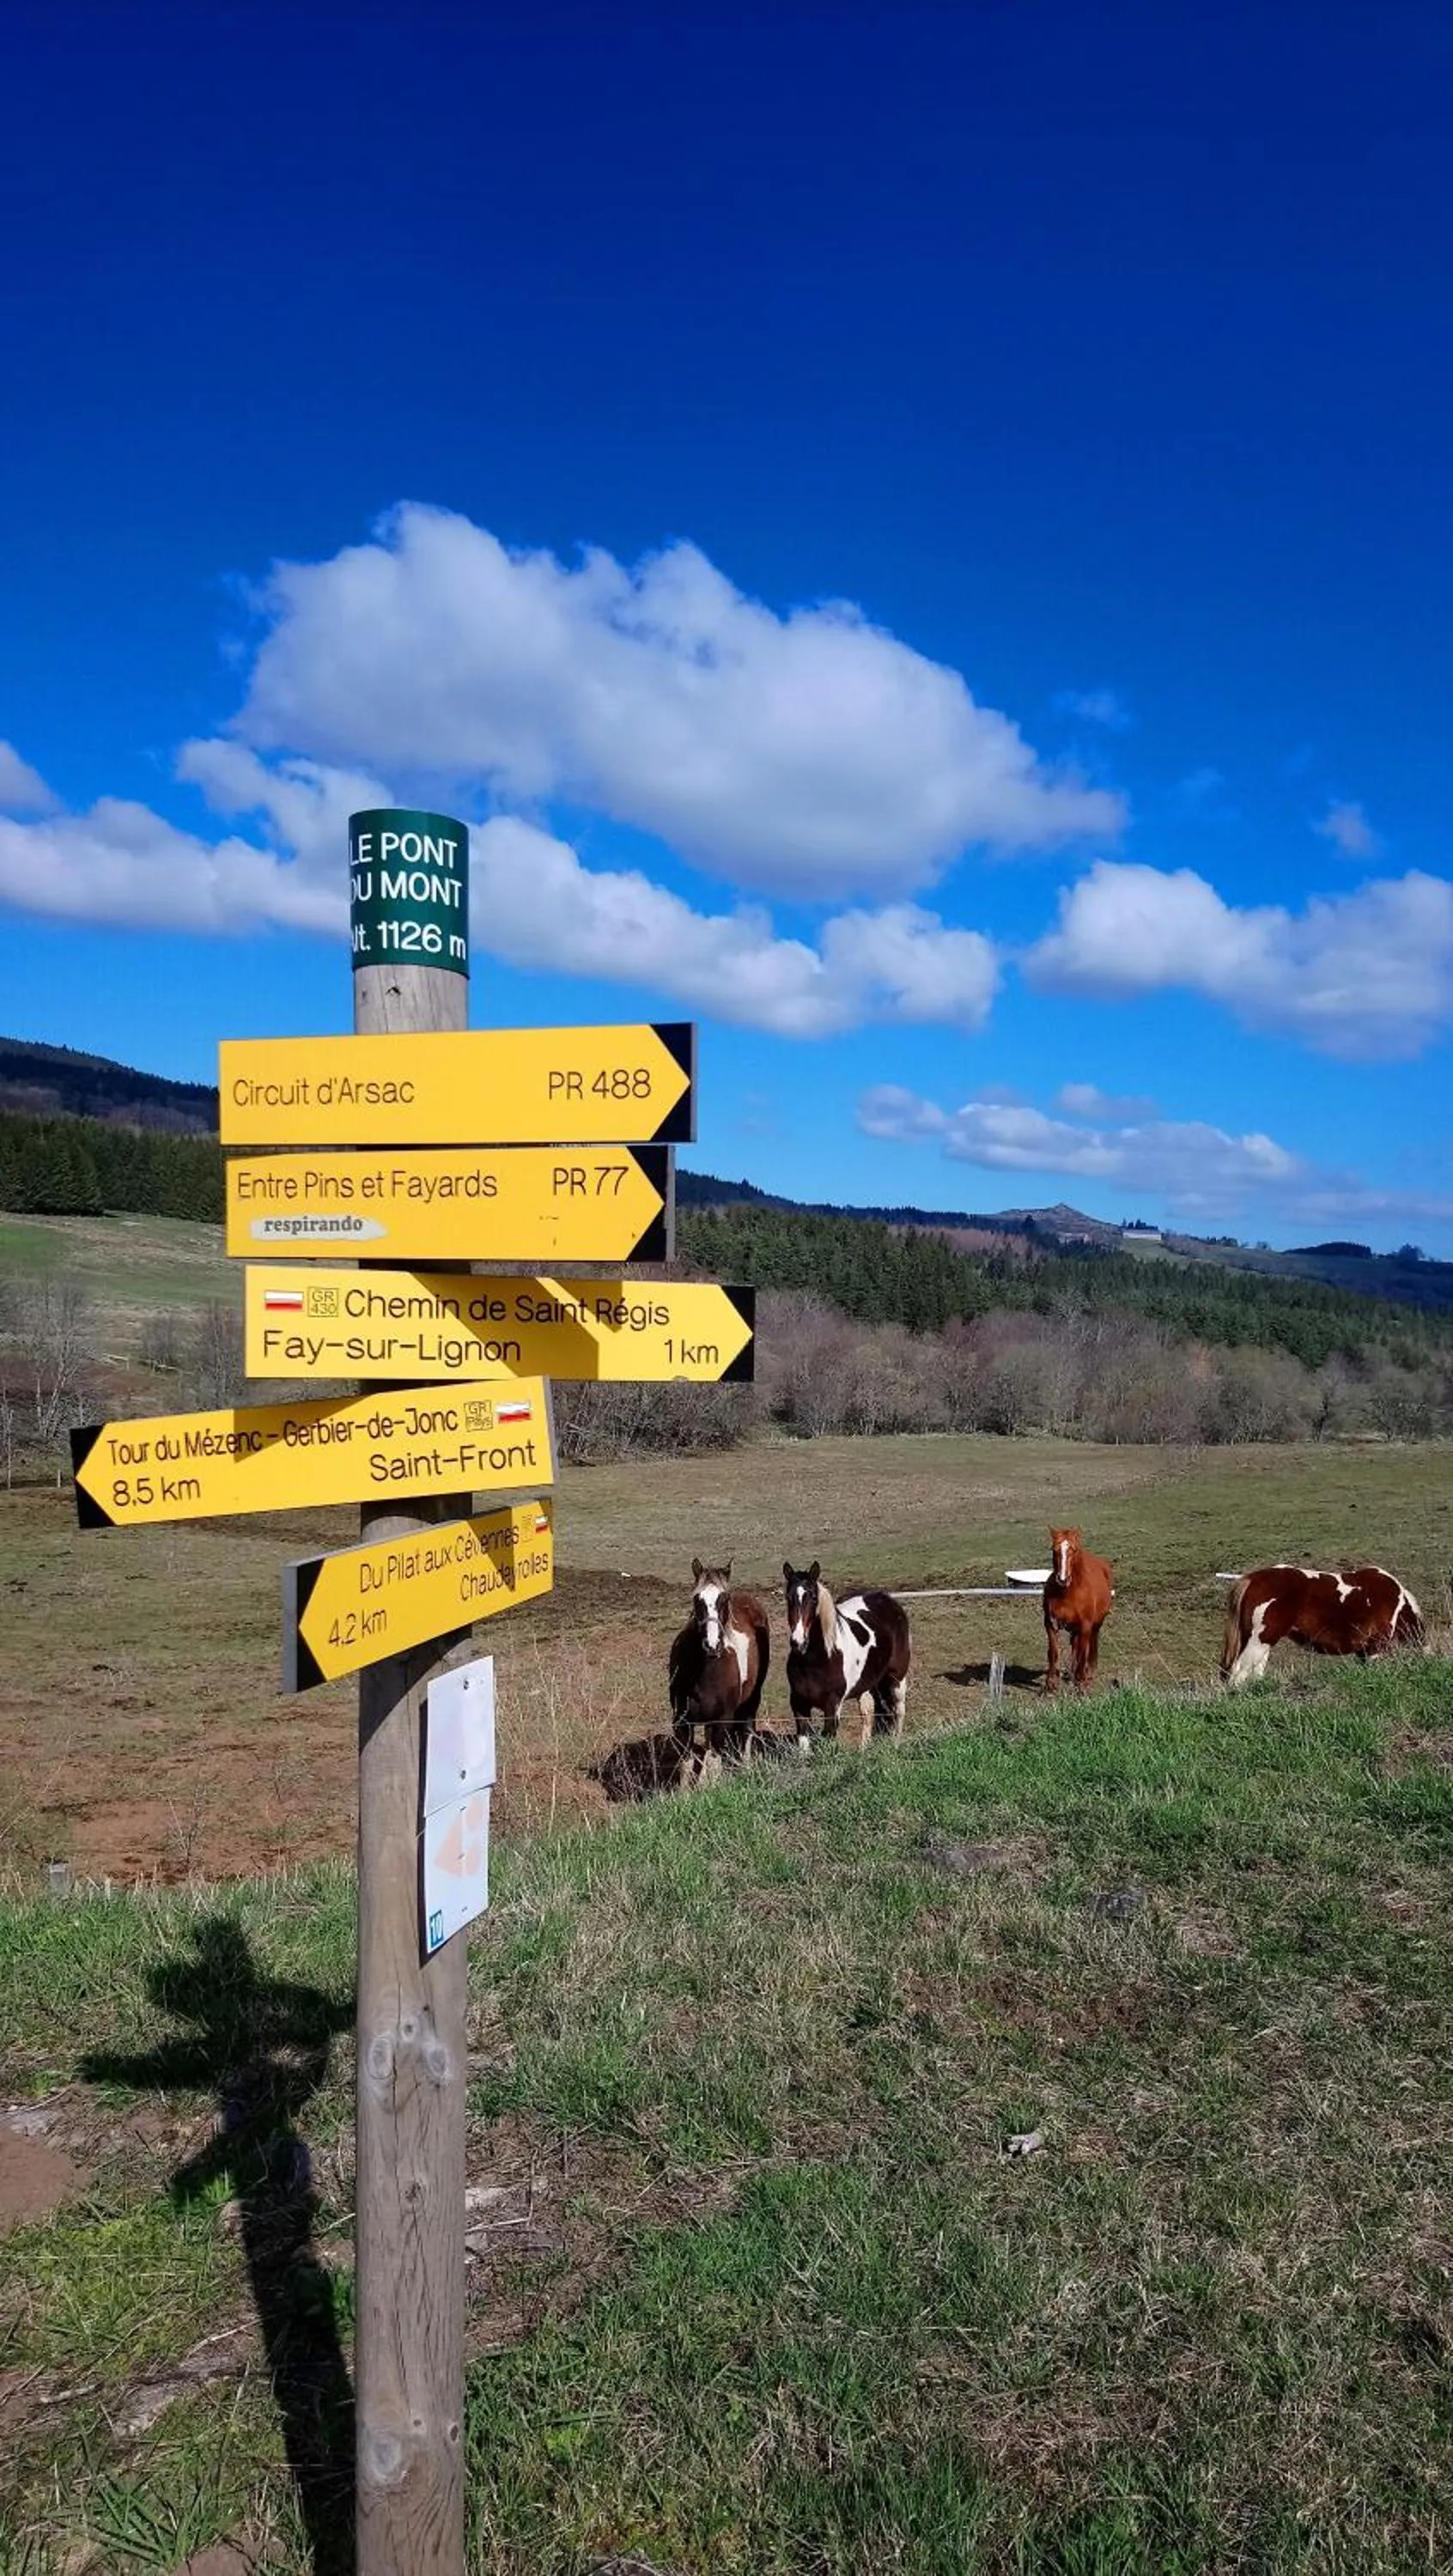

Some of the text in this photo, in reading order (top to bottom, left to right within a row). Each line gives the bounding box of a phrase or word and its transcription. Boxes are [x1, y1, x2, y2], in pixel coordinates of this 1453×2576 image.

[350, 832, 458, 869] LE PONT
[380, 870, 463, 908] MONT
[352, 920, 466, 960] lt. 1126 m
[233, 1077, 415, 1107] Circuit d'Arsac
[549, 1069, 652, 1100] PR 488
[237, 1169, 498, 1202] Entre Pins et Fayards
[553, 1166, 629, 1196] PR 77
[264, 1216, 363, 1235] respirando
[312, 1291, 334, 1302] GR
[344, 1290, 670, 1331] Chemin de Saint Régis
[264, 1330, 521, 1367] Fay-sur-Lignon
[664, 1339, 719, 1364] 1 km
[107, 1438, 149, 1465] Tour
[155, 1435, 179, 1461] du
[185, 1428, 262, 1457] Mézenc
[282, 1408, 459, 1447] Gerbier-de-Jonc
[369, 1439, 537, 1482] Saint-Front
[161, 1476, 201, 1502] km
[360, 1563, 384, 1593] Du
[387, 1549, 421, 1584] Pilat
[424, 1545, 453, 1572] aux
[455, 1526, 520, 1563] Cévennes
[362, 1607, 387, 1639] km
